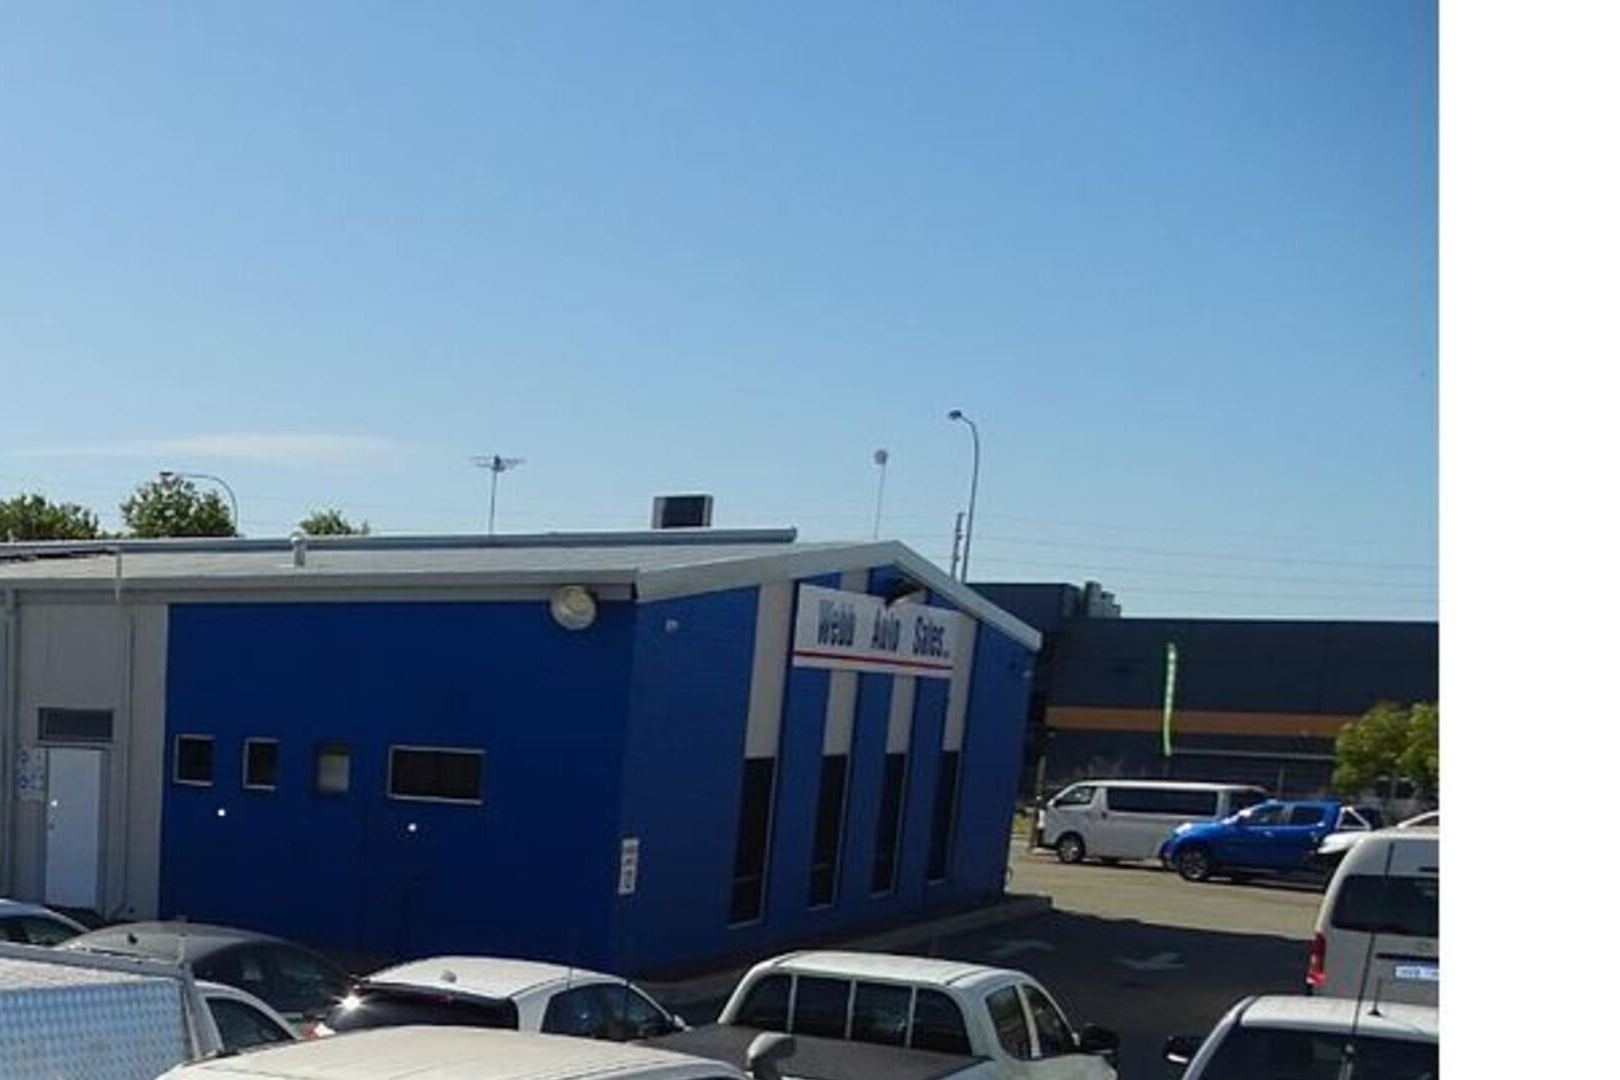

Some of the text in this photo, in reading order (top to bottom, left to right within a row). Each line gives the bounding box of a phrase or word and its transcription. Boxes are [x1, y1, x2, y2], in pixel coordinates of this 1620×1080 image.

[817, 600, 945, 657] Webb Auto Sales
